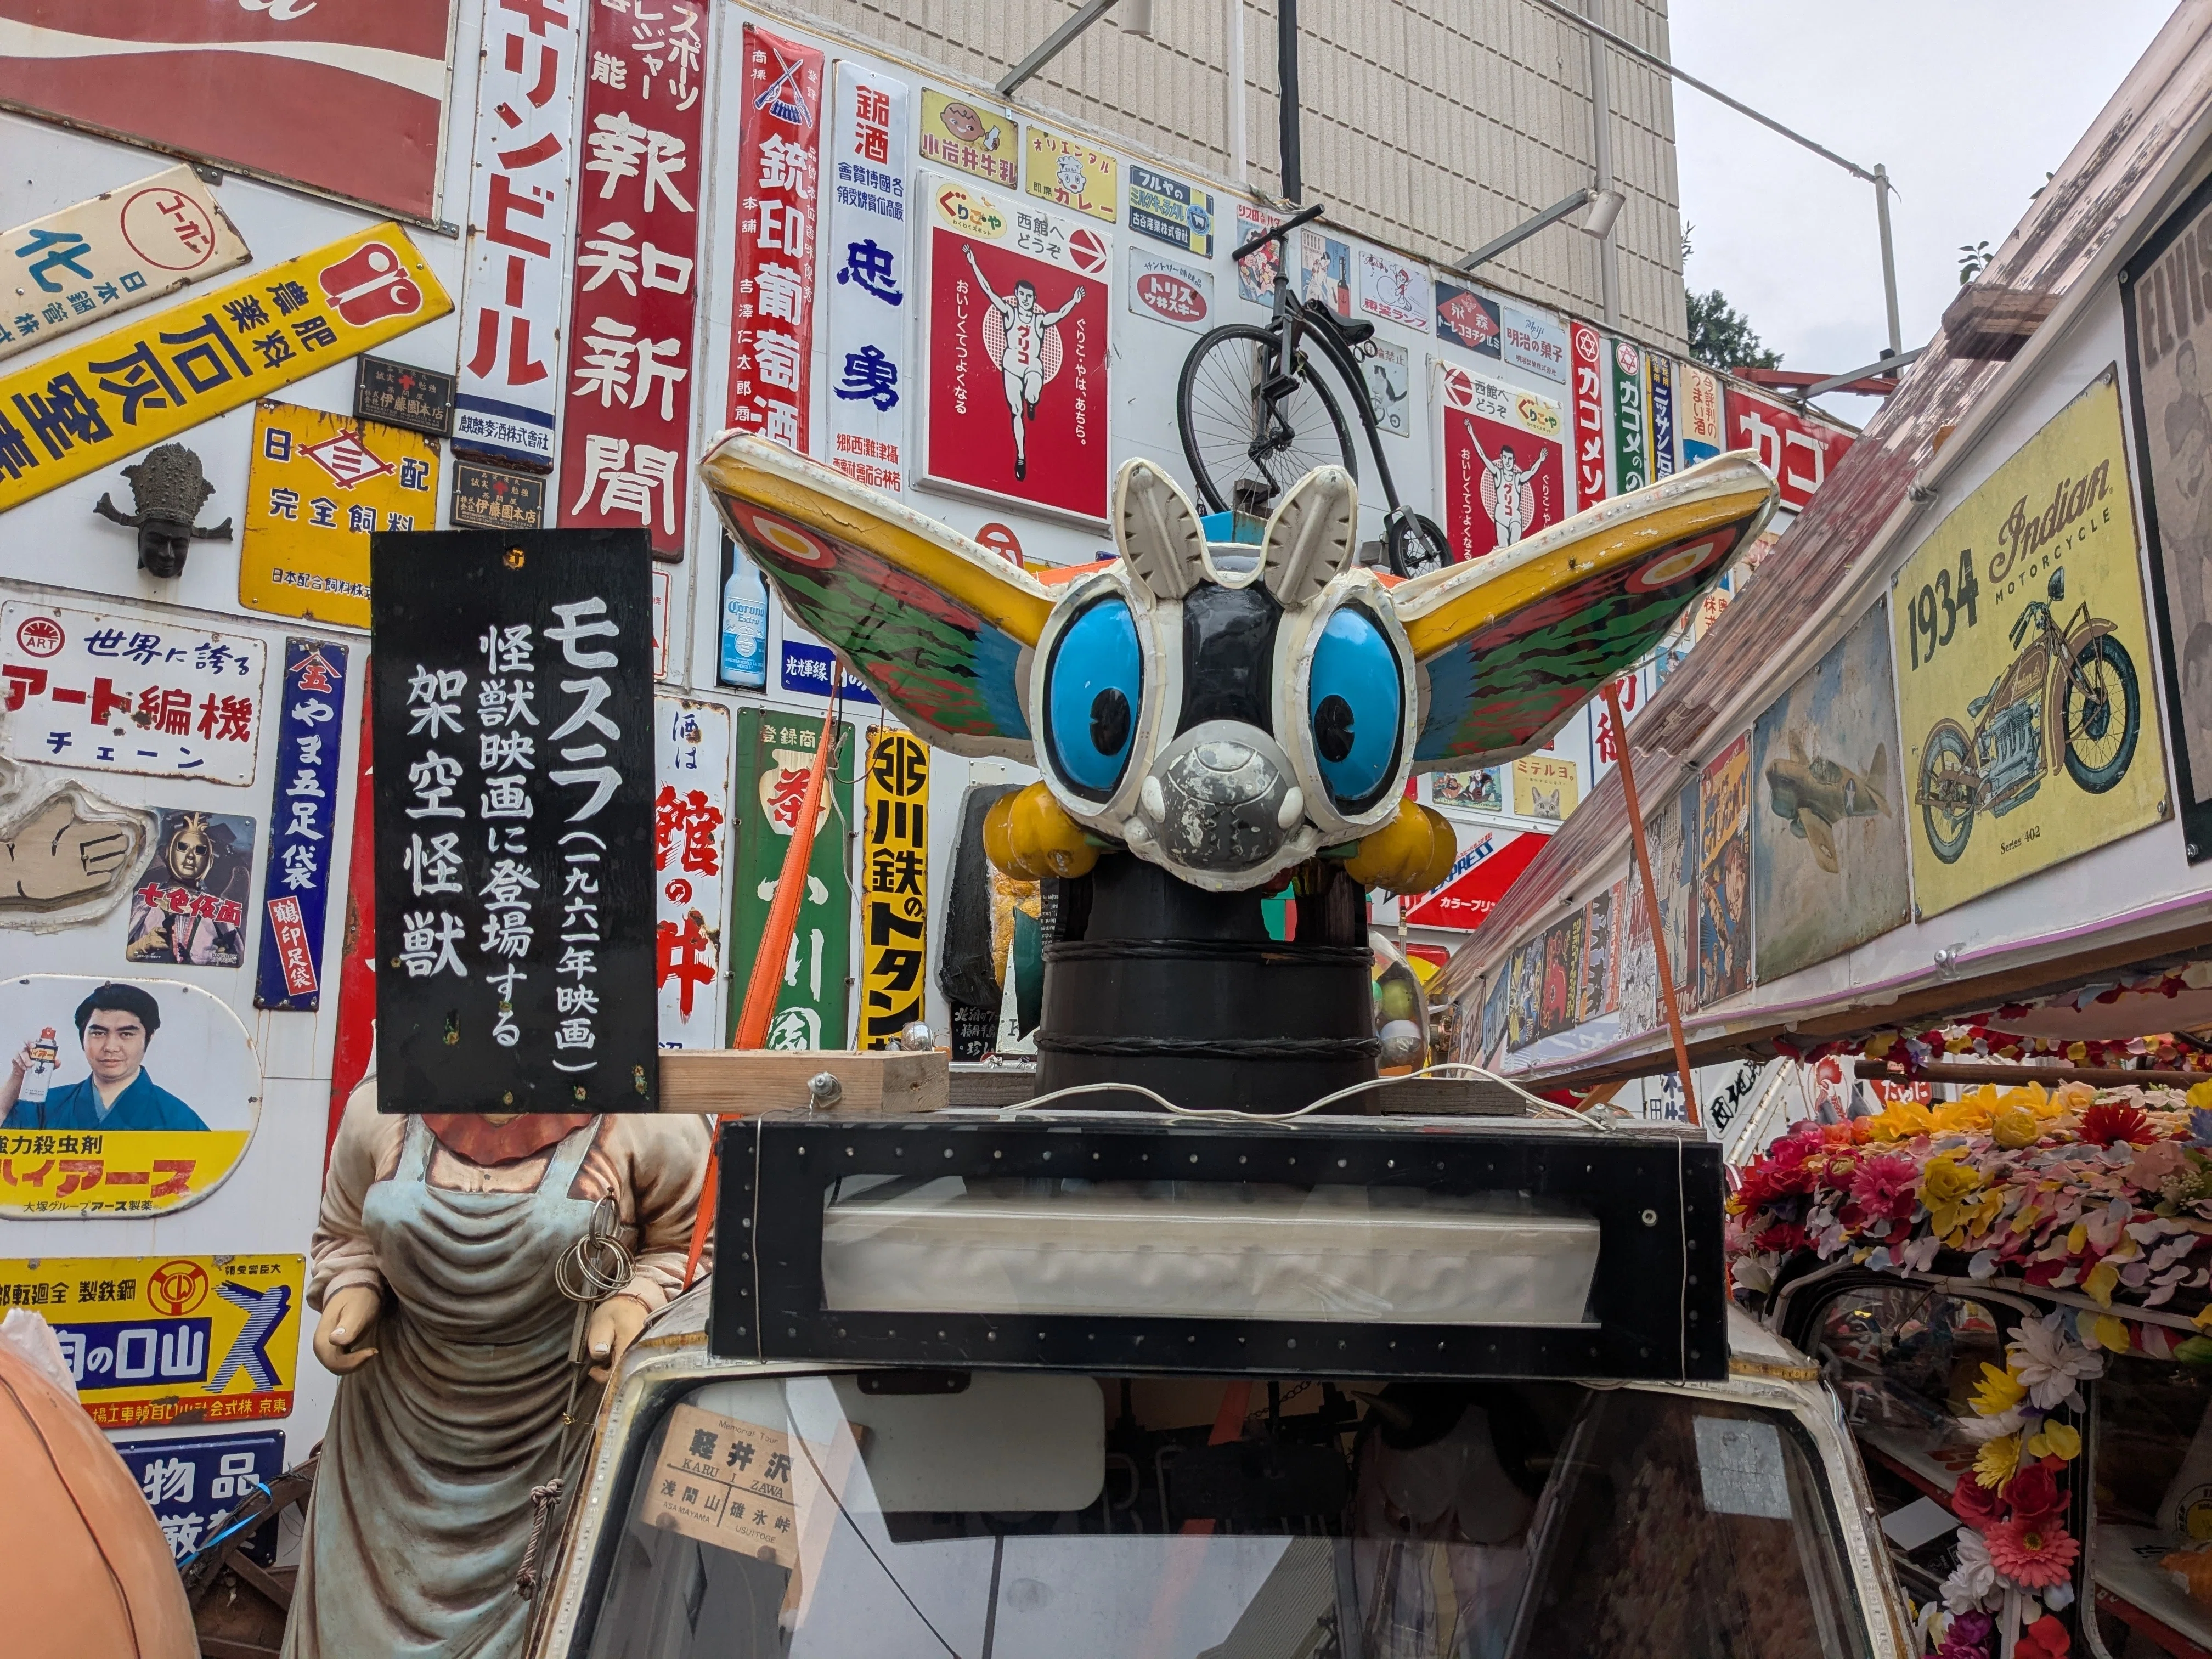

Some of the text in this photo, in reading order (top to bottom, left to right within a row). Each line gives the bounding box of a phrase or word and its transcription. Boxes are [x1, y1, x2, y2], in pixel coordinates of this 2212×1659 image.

[668, 5, 701, 111] スポーツ
[923, 133, 1017, 185] 小岩井牛乳
[1034, 138, 1110, 174] オリエンタル
[1139, 172, 1183, 200] フルヤの
[1017, 211, 1065, 241] 西館へ
[1017, 232, 1062, 260] どうぞ
[222, 280, 309, 334] 農薬
[1150, 276, 1198, 306] トリス
[253, 315, 338, 369] 肥料
[572, 111, 695, 535] 報知新聞
[955, 279, 969, 415] おいしくてつよくなる
[1017, 324, 1032, 366] グリコ
[1506, 328, 1563, 363] 明治の菓子
[380, 392, 444, 420] 伊藤園本店
[1474, 379, 1509, 402] 西館へ
[1476, 398, 1507, 419] どうぞ
[1578, 366, 1604, 506] カゴメソ
[475, 498, 537, 524] 伊藤園本店
[1503, 483, 1514, 517] グリコ
[1988, 458, 2110, 586] Indian
[1995, 507, 2112, 606] MOTORCYCLE
[727, 600, 765, 617] Corona
[1907, 547, 1979, 672] 1934
[26, 637, 56, 650] ART
[83, 628, 250, 676] 世界に誇る
[1, 664, 253, 743] アート編機
[46, 731, 204, 768] チェーン
[399, 664, 468, 978] 架空怪獣
[476, 624, 540, 1047] 怪獣映画に登場する
[2000, 826, 2041, 855] Series 402
[718, 1419, 755, 1437] Memorial
[689, 1427, 794, 1484] 軽井沢
[660, 1478, 721, 1513] 浅間山
[681, 1458, 720, 1478] KARU
[750, 1480, 785, 1499] ZAWA
